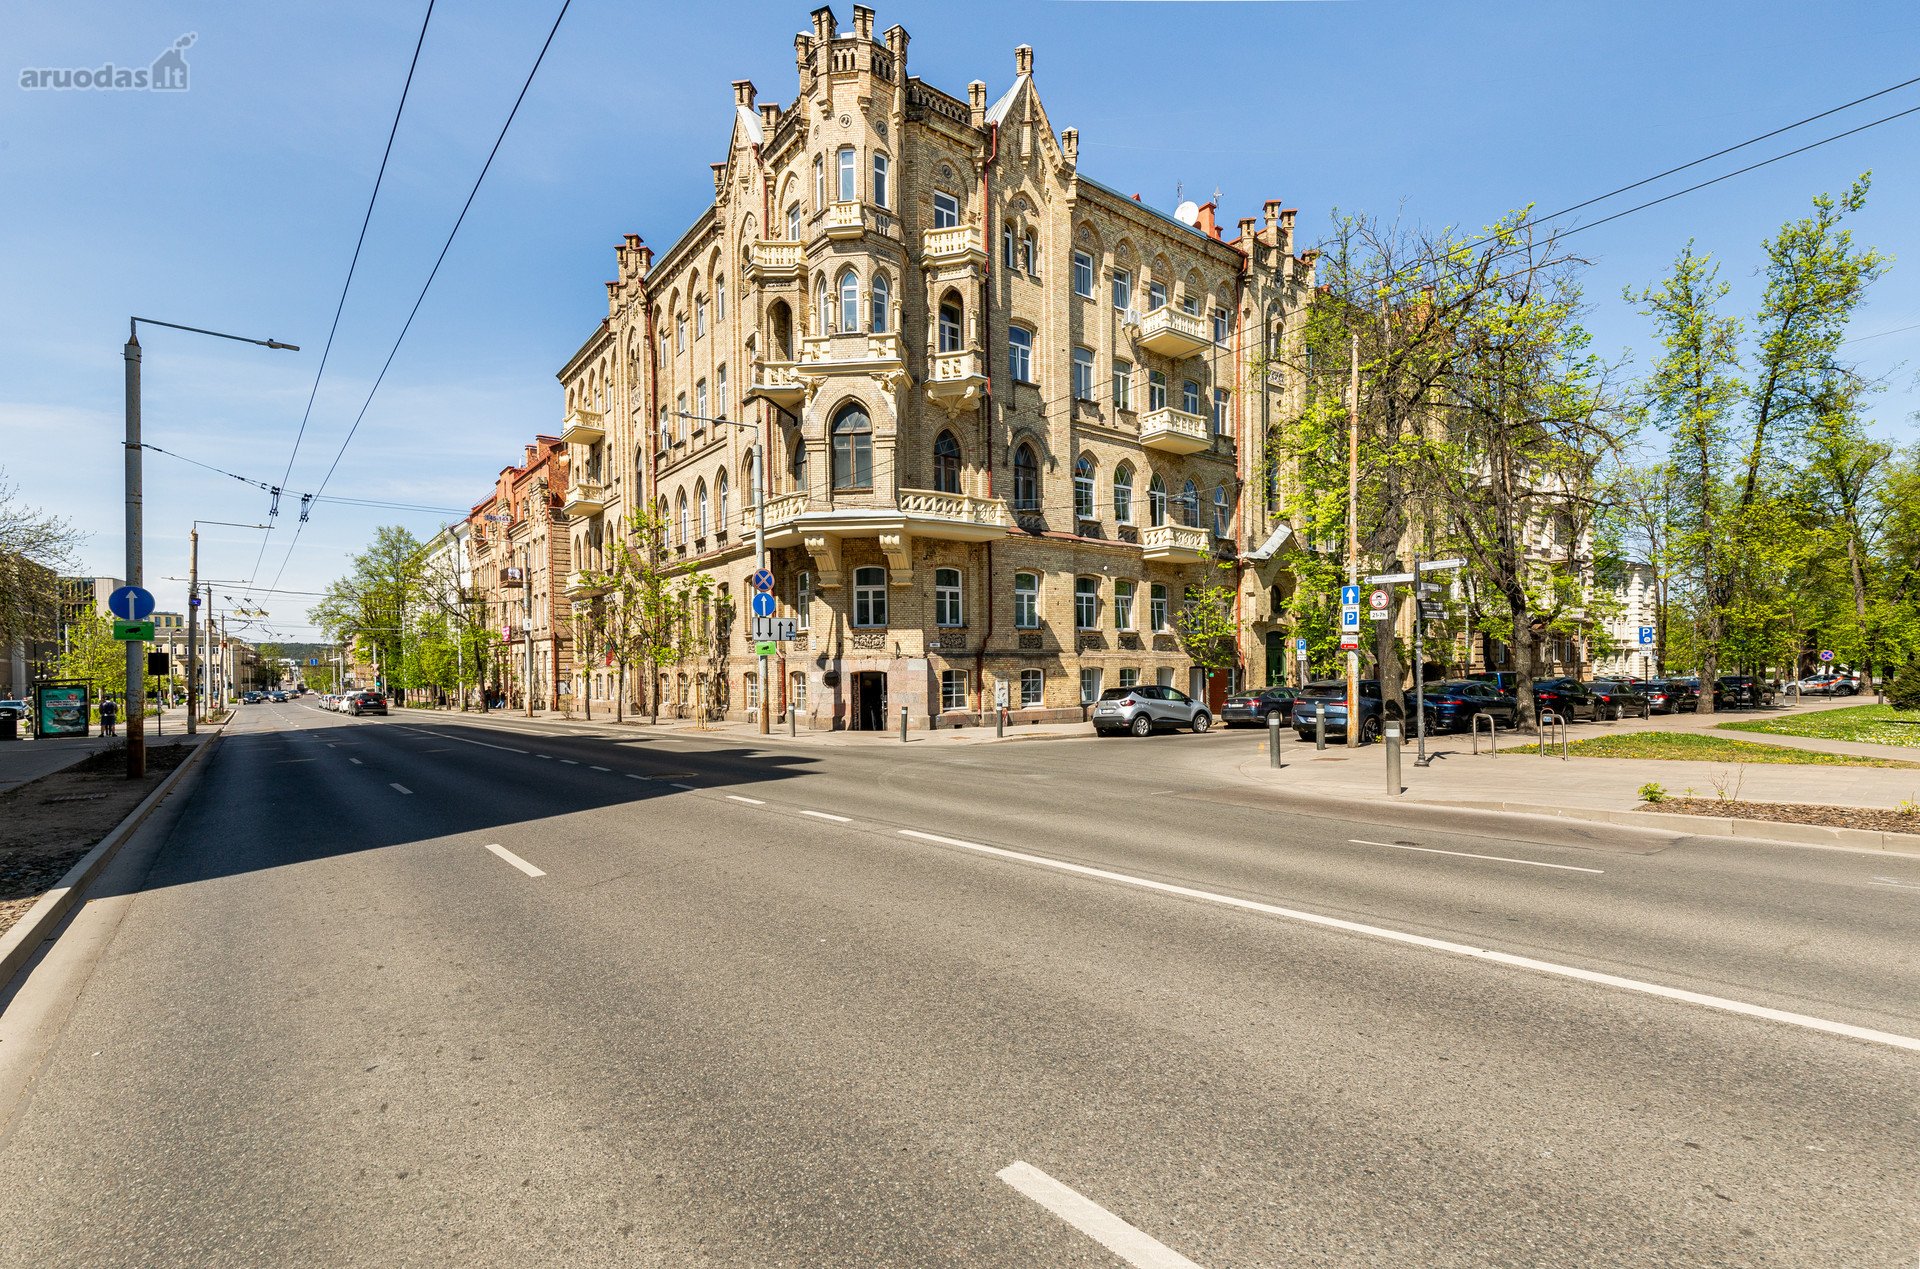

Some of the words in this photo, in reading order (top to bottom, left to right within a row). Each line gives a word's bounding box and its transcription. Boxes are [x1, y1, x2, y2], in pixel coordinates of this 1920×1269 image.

[1347, 612, 1355, 624] P
[1643, 628, 1650, 637] P
[1299, 640, 1305, 649] P
